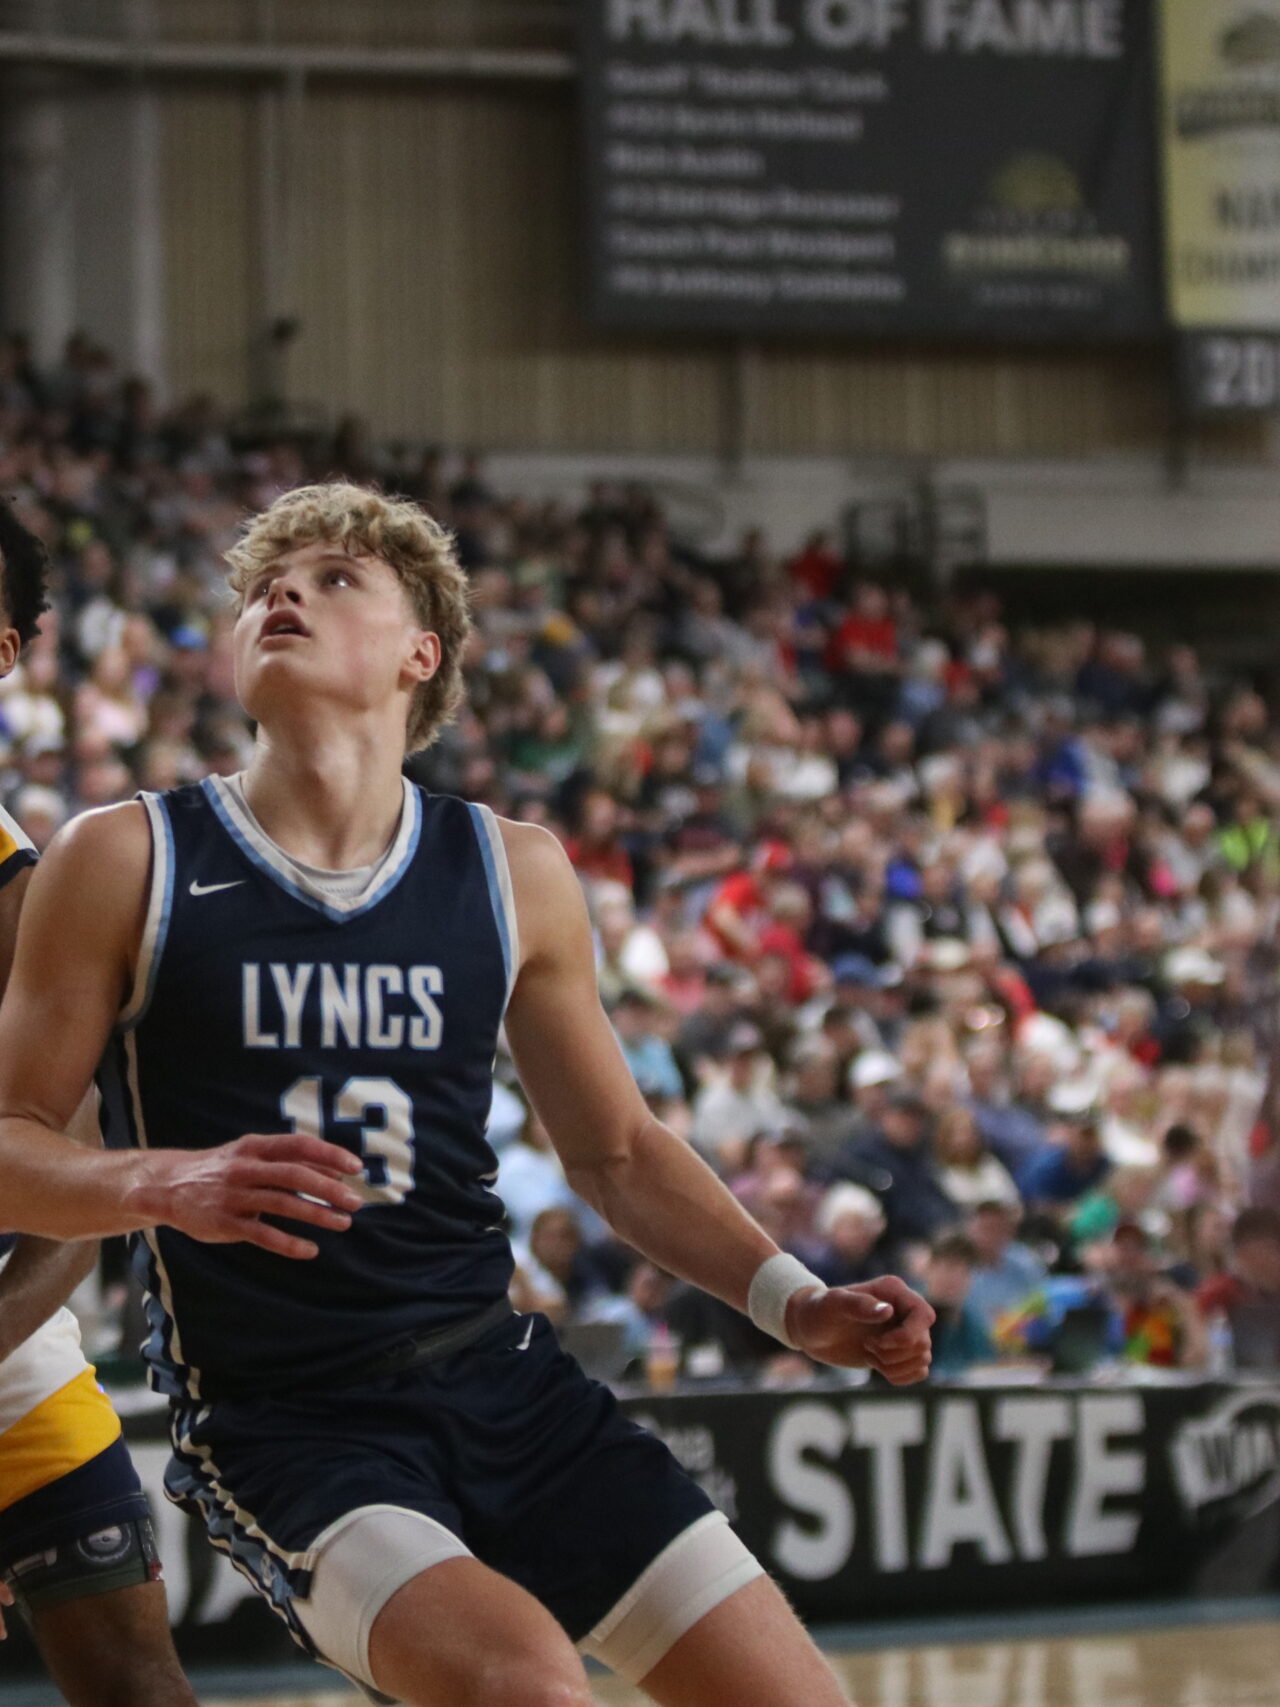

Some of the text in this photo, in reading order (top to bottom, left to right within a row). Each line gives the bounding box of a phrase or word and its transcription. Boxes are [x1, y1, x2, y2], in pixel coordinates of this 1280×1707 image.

[607, 0, 1122, 57] HALL OF FAME
[242, 962, 444, 1051] LYNCS
[280, 1076, 414, 1205] 13
[766, 1395, 1148, 1583] STATE
